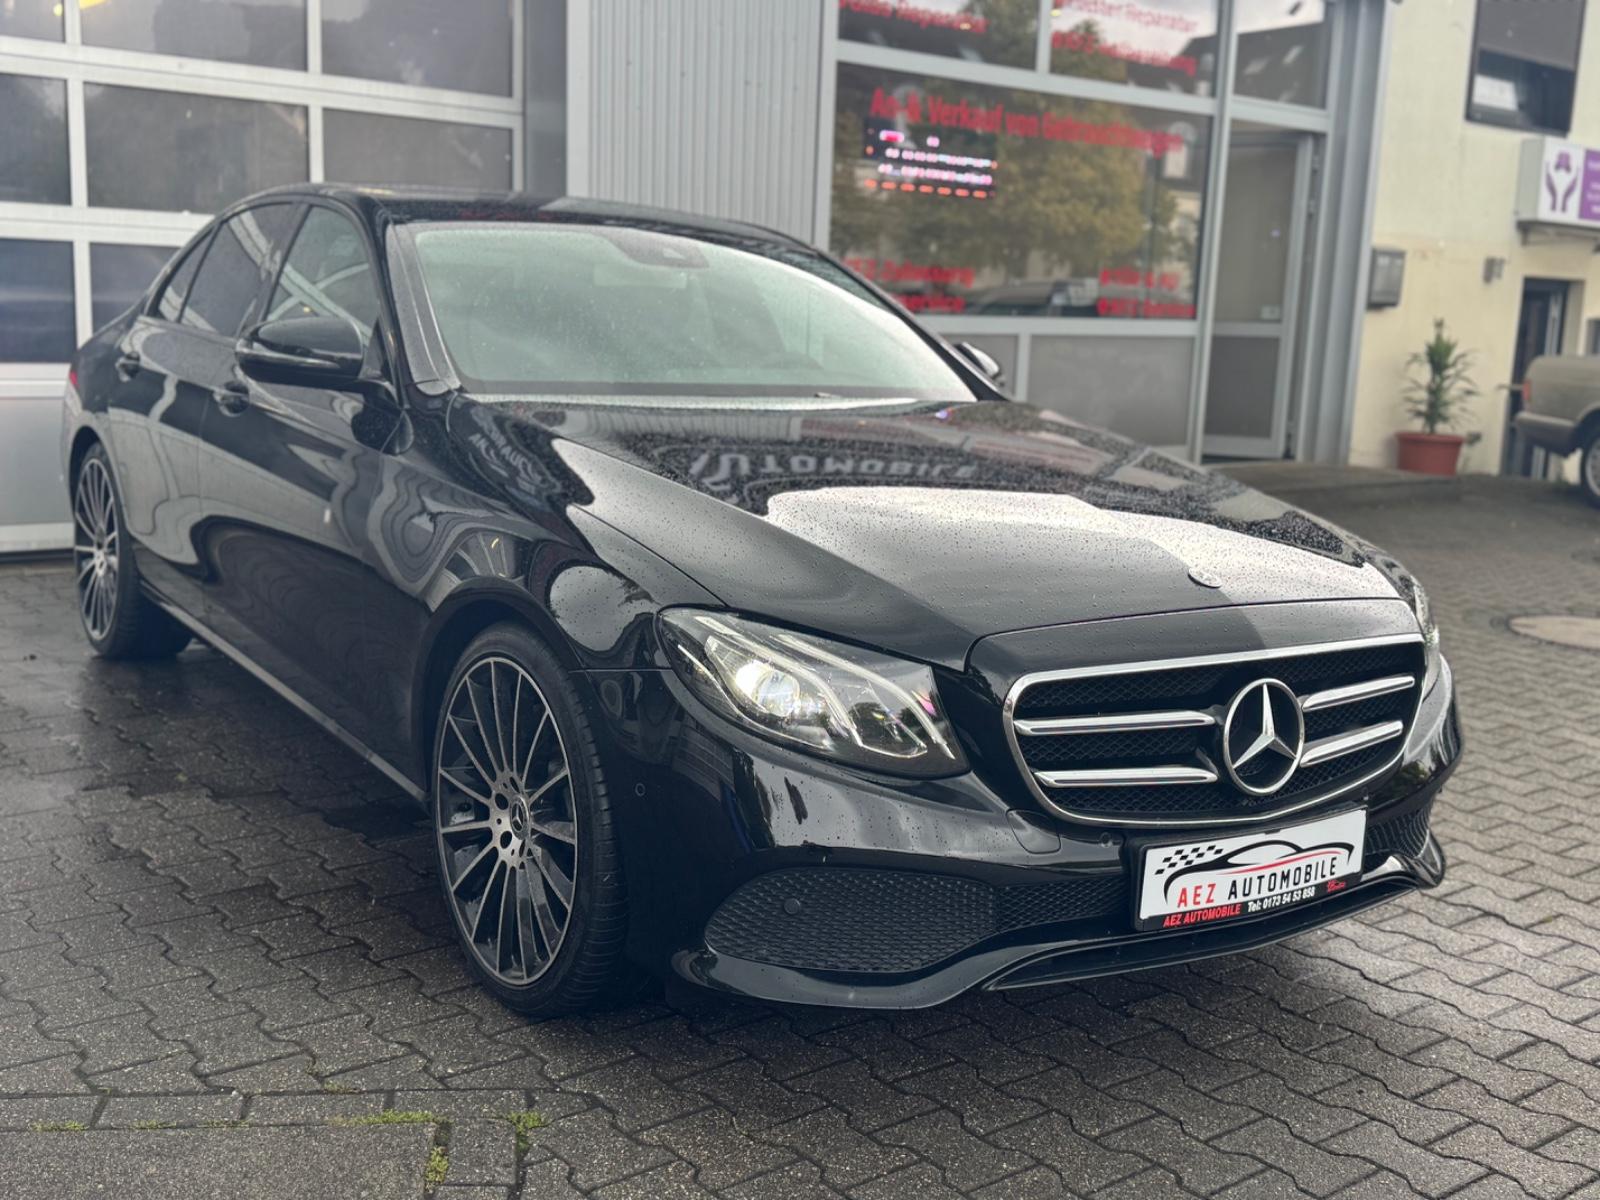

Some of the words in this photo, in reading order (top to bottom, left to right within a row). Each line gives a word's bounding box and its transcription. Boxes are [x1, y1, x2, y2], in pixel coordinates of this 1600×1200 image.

[1177, 883, 1216, 908] AEZ
[1228, 857, 1337, 900] AUTOMOBILE
[1163, 910, 1182, 928] AEZ
[1183, 904, 1242, 926] AUTOMOBILE
[1248, 900, 1261, 913] Tel:
[1263, 895, 1281, 909] 0173
